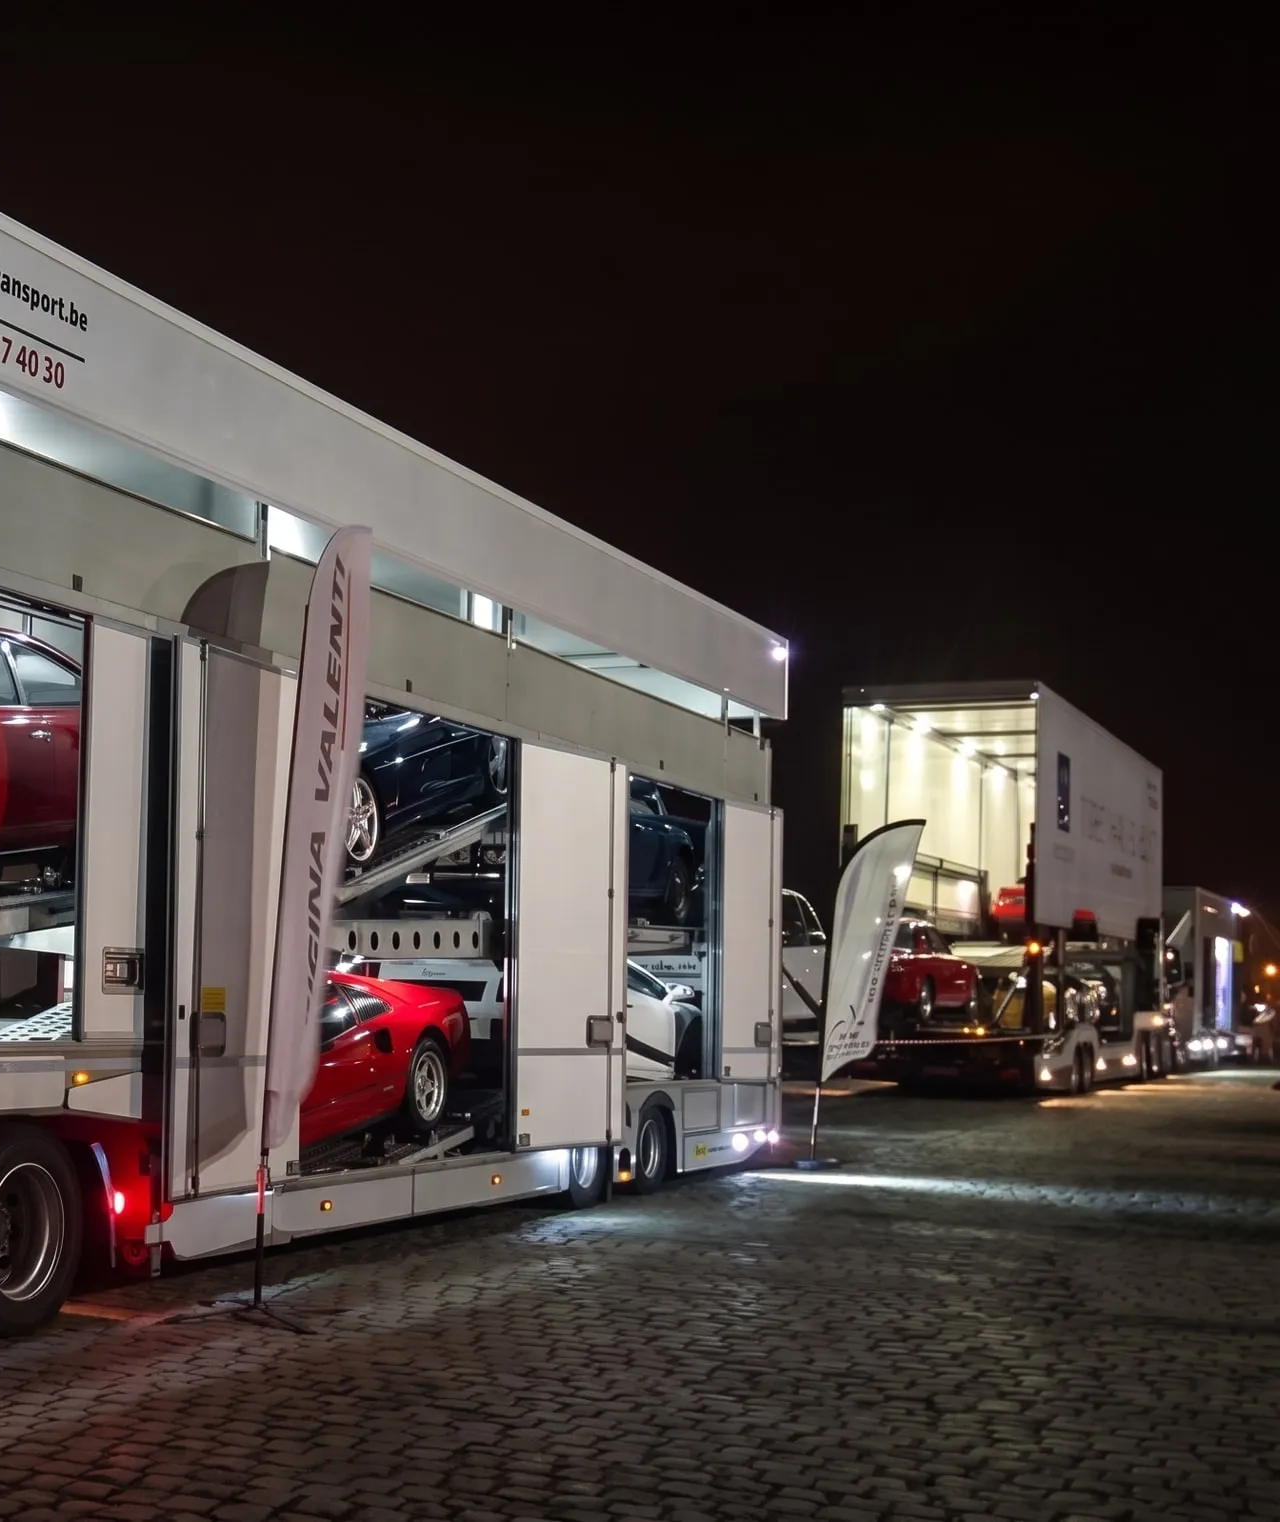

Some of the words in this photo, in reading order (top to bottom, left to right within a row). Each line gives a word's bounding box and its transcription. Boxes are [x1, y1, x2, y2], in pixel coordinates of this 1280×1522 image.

[16, 345, 39, 377] 40
[43, 356, 66, 389] 30
[314, 552, 347, 801] VALENTI
